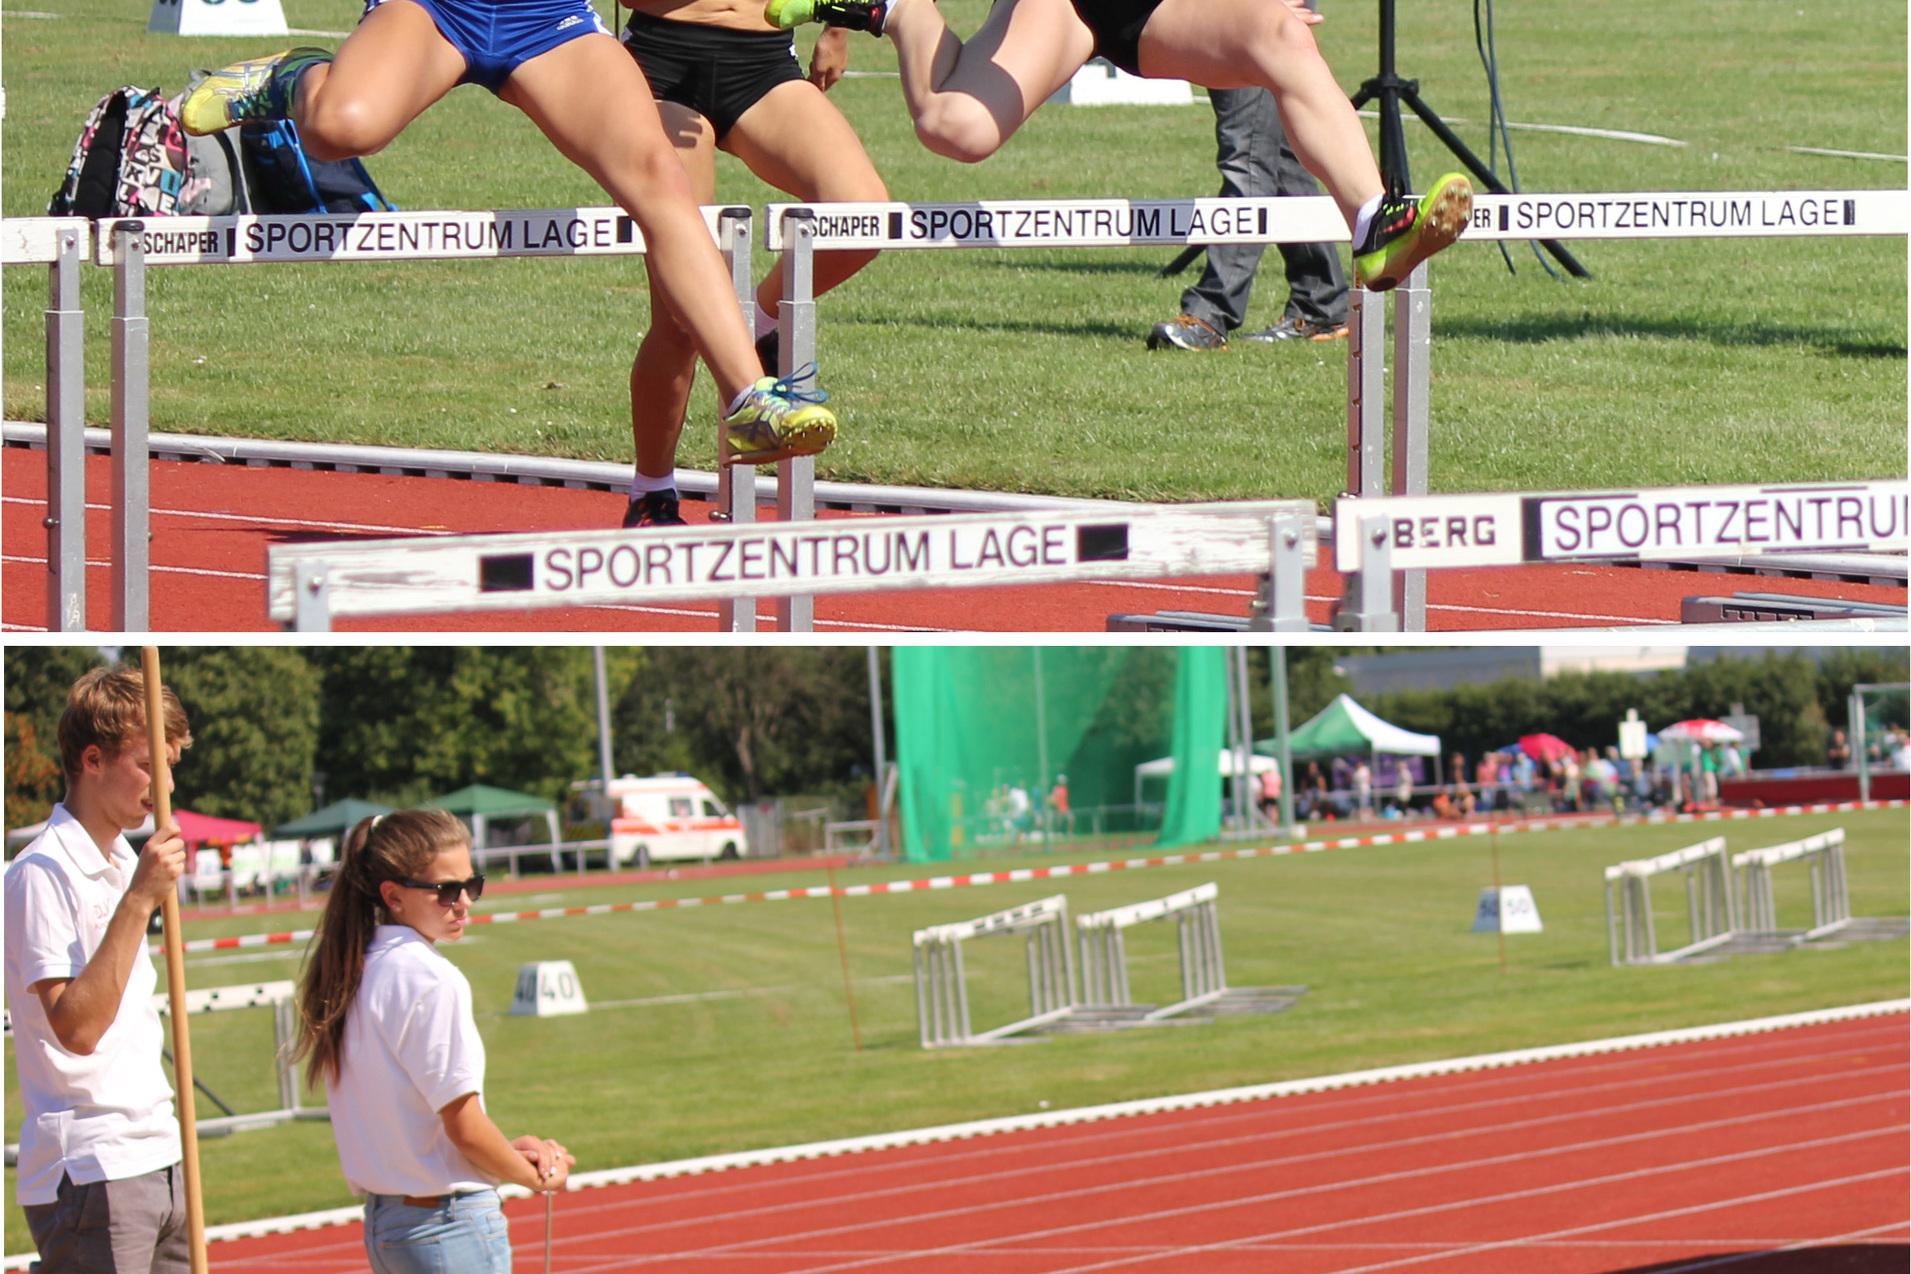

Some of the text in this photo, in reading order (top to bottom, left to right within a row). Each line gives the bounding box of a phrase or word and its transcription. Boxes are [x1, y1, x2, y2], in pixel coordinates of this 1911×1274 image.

[910, 208, 1160, 239] SPORTZENTRUM
[1170, 207, 1252, 237] LAGE
[1517, 201, 1751, 229] SPORTZENTRUM
[1762, 199, 1838, 226] LAGE
[245, 219, 512, 253] SPORTZENTRUM
[523, 218, 611, 249] LAGE
[1393, 494, 1909, 551] BERG SPORTZENTRU
[544, 525, 1067, 592] SPORTZENTRUM LAGE
[541, 972, 575, 1001] 40
